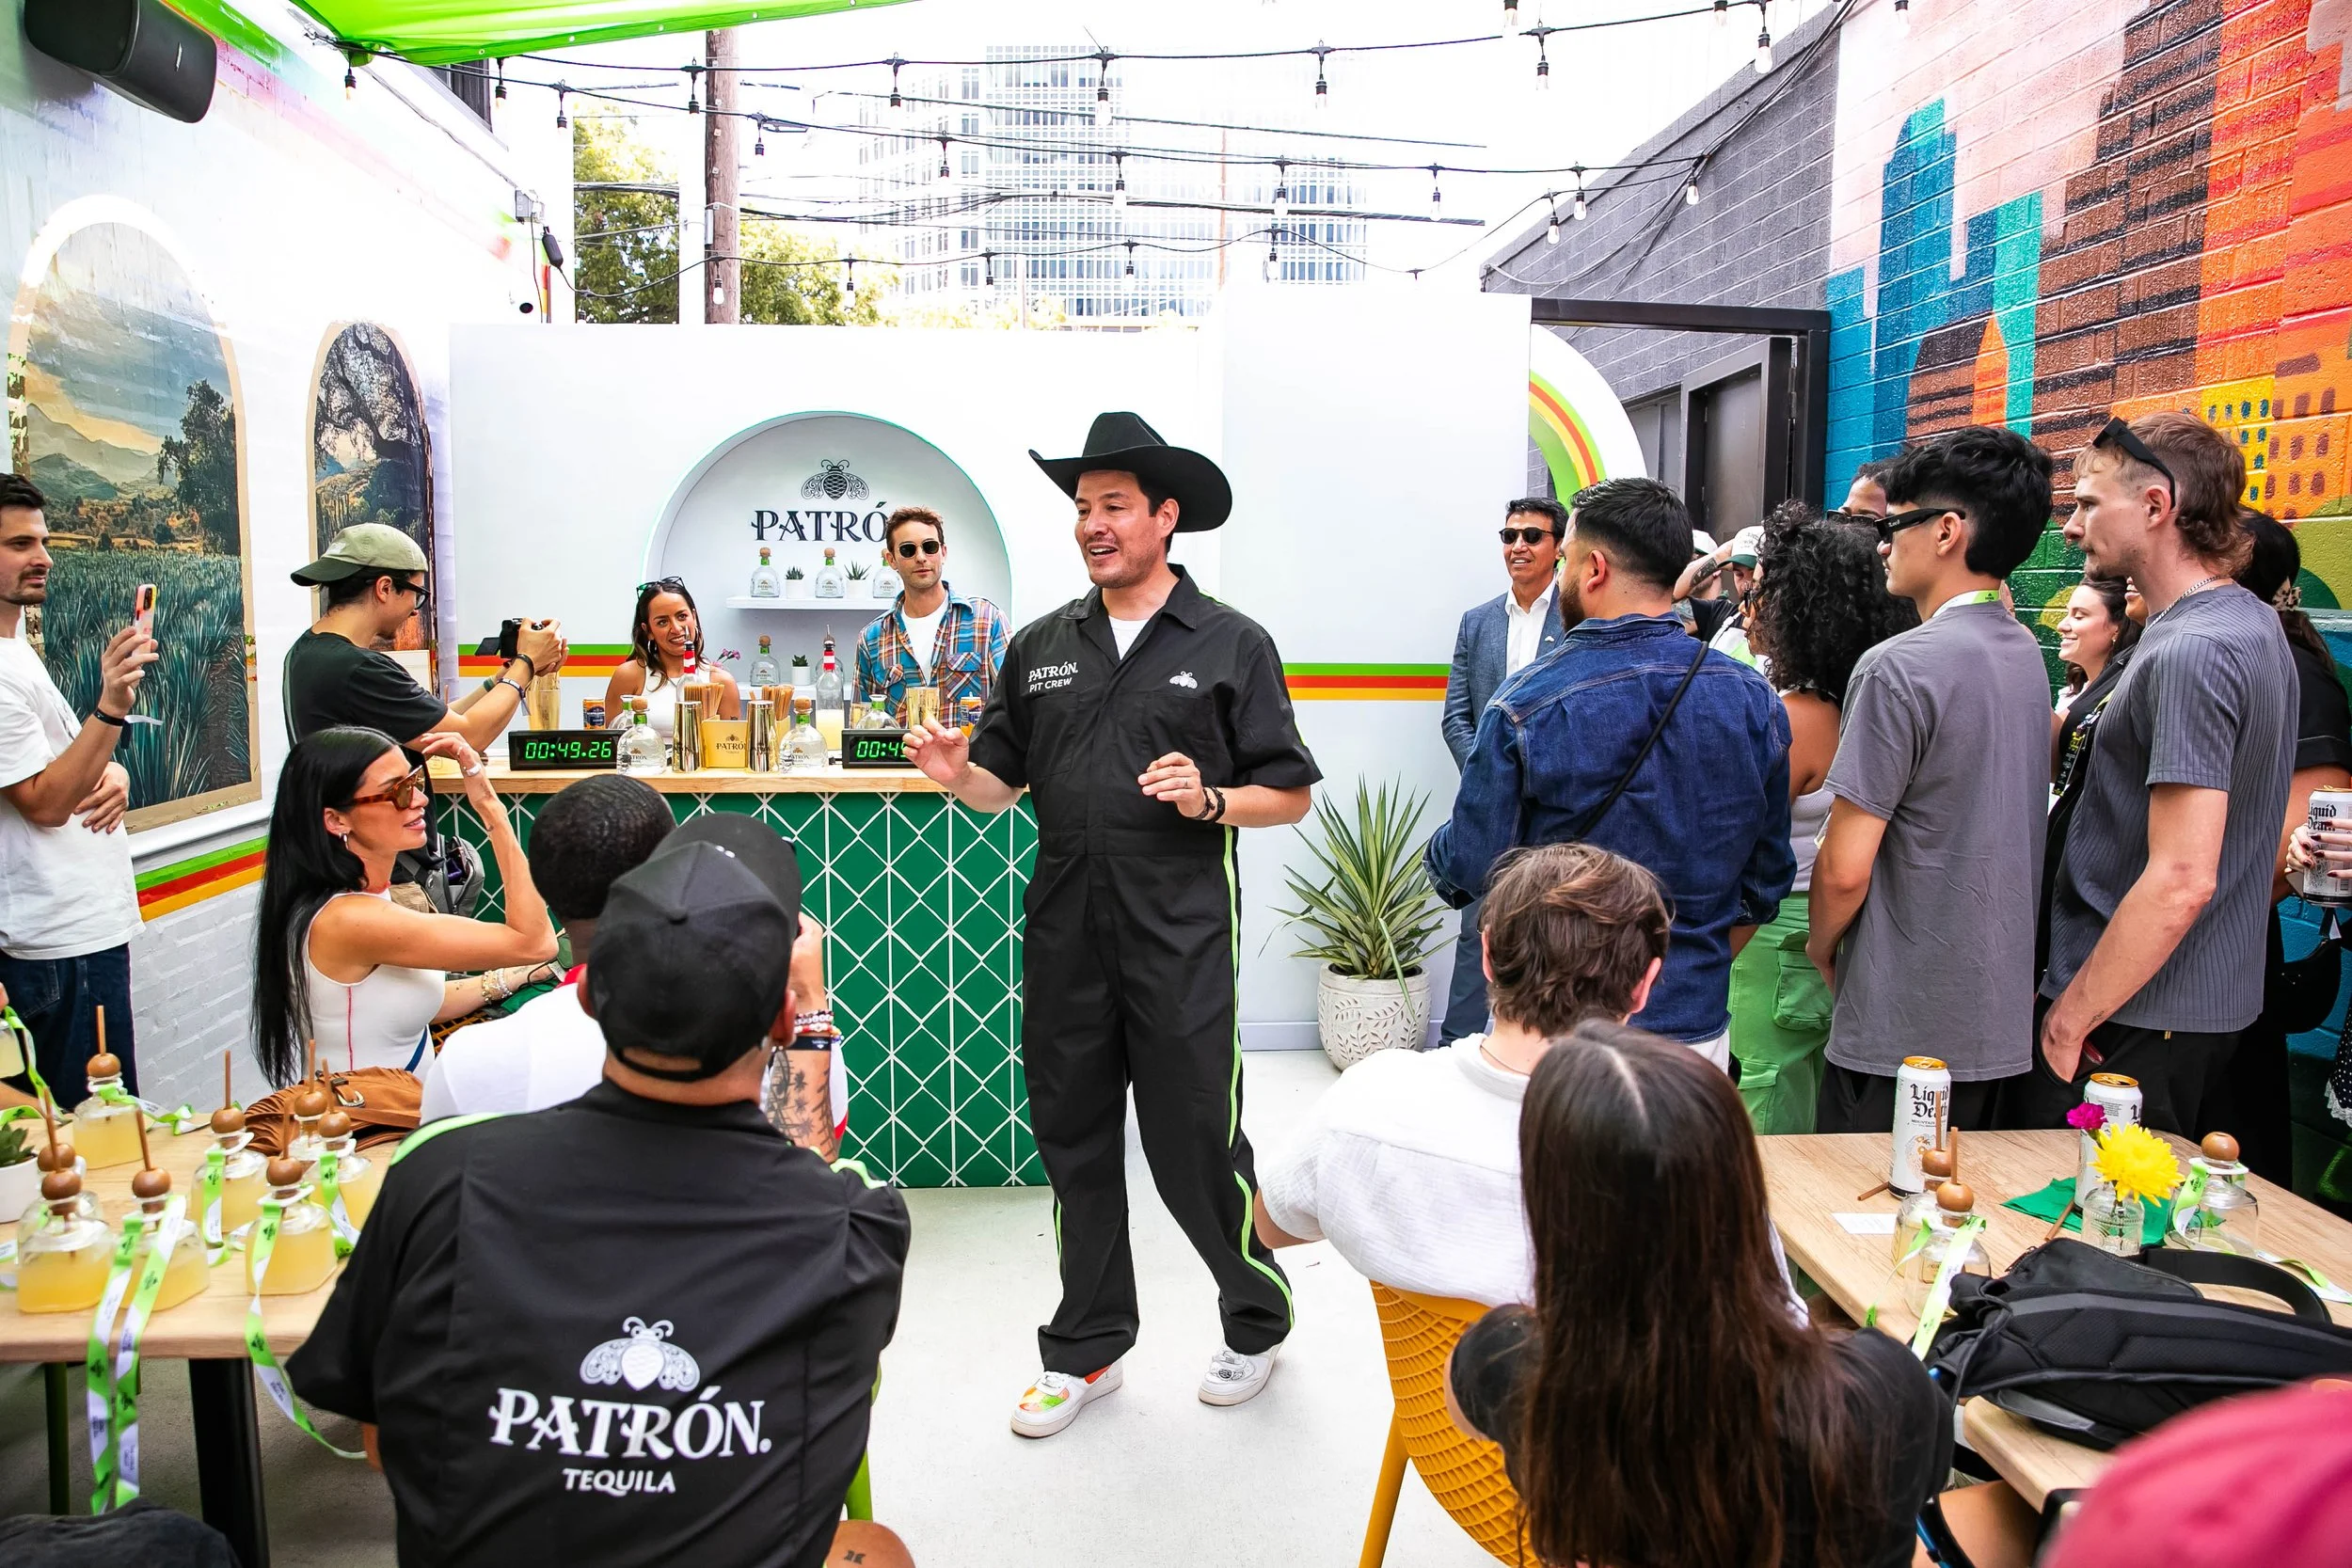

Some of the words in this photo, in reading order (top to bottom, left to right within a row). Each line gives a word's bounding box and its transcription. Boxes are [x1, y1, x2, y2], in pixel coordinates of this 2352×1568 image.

[751, 501, 888, 543] PATRÓ
[1029, 682, 1043, 692] PIT
[1044, 677, 1073, 689] CREW
[525, 741, 612, 759] 00:49.26
[715, 741, 746, 751] PATRÓ
[2308, 802, 2336, 820] iquid
[2308, 816, 2335, 832] Dea
[1910, 1083, 1948, 1105] Liqid
[1912, 1101, 1947, 1117] Deth
[563, 1467, 676, 1497] TEQUILA
